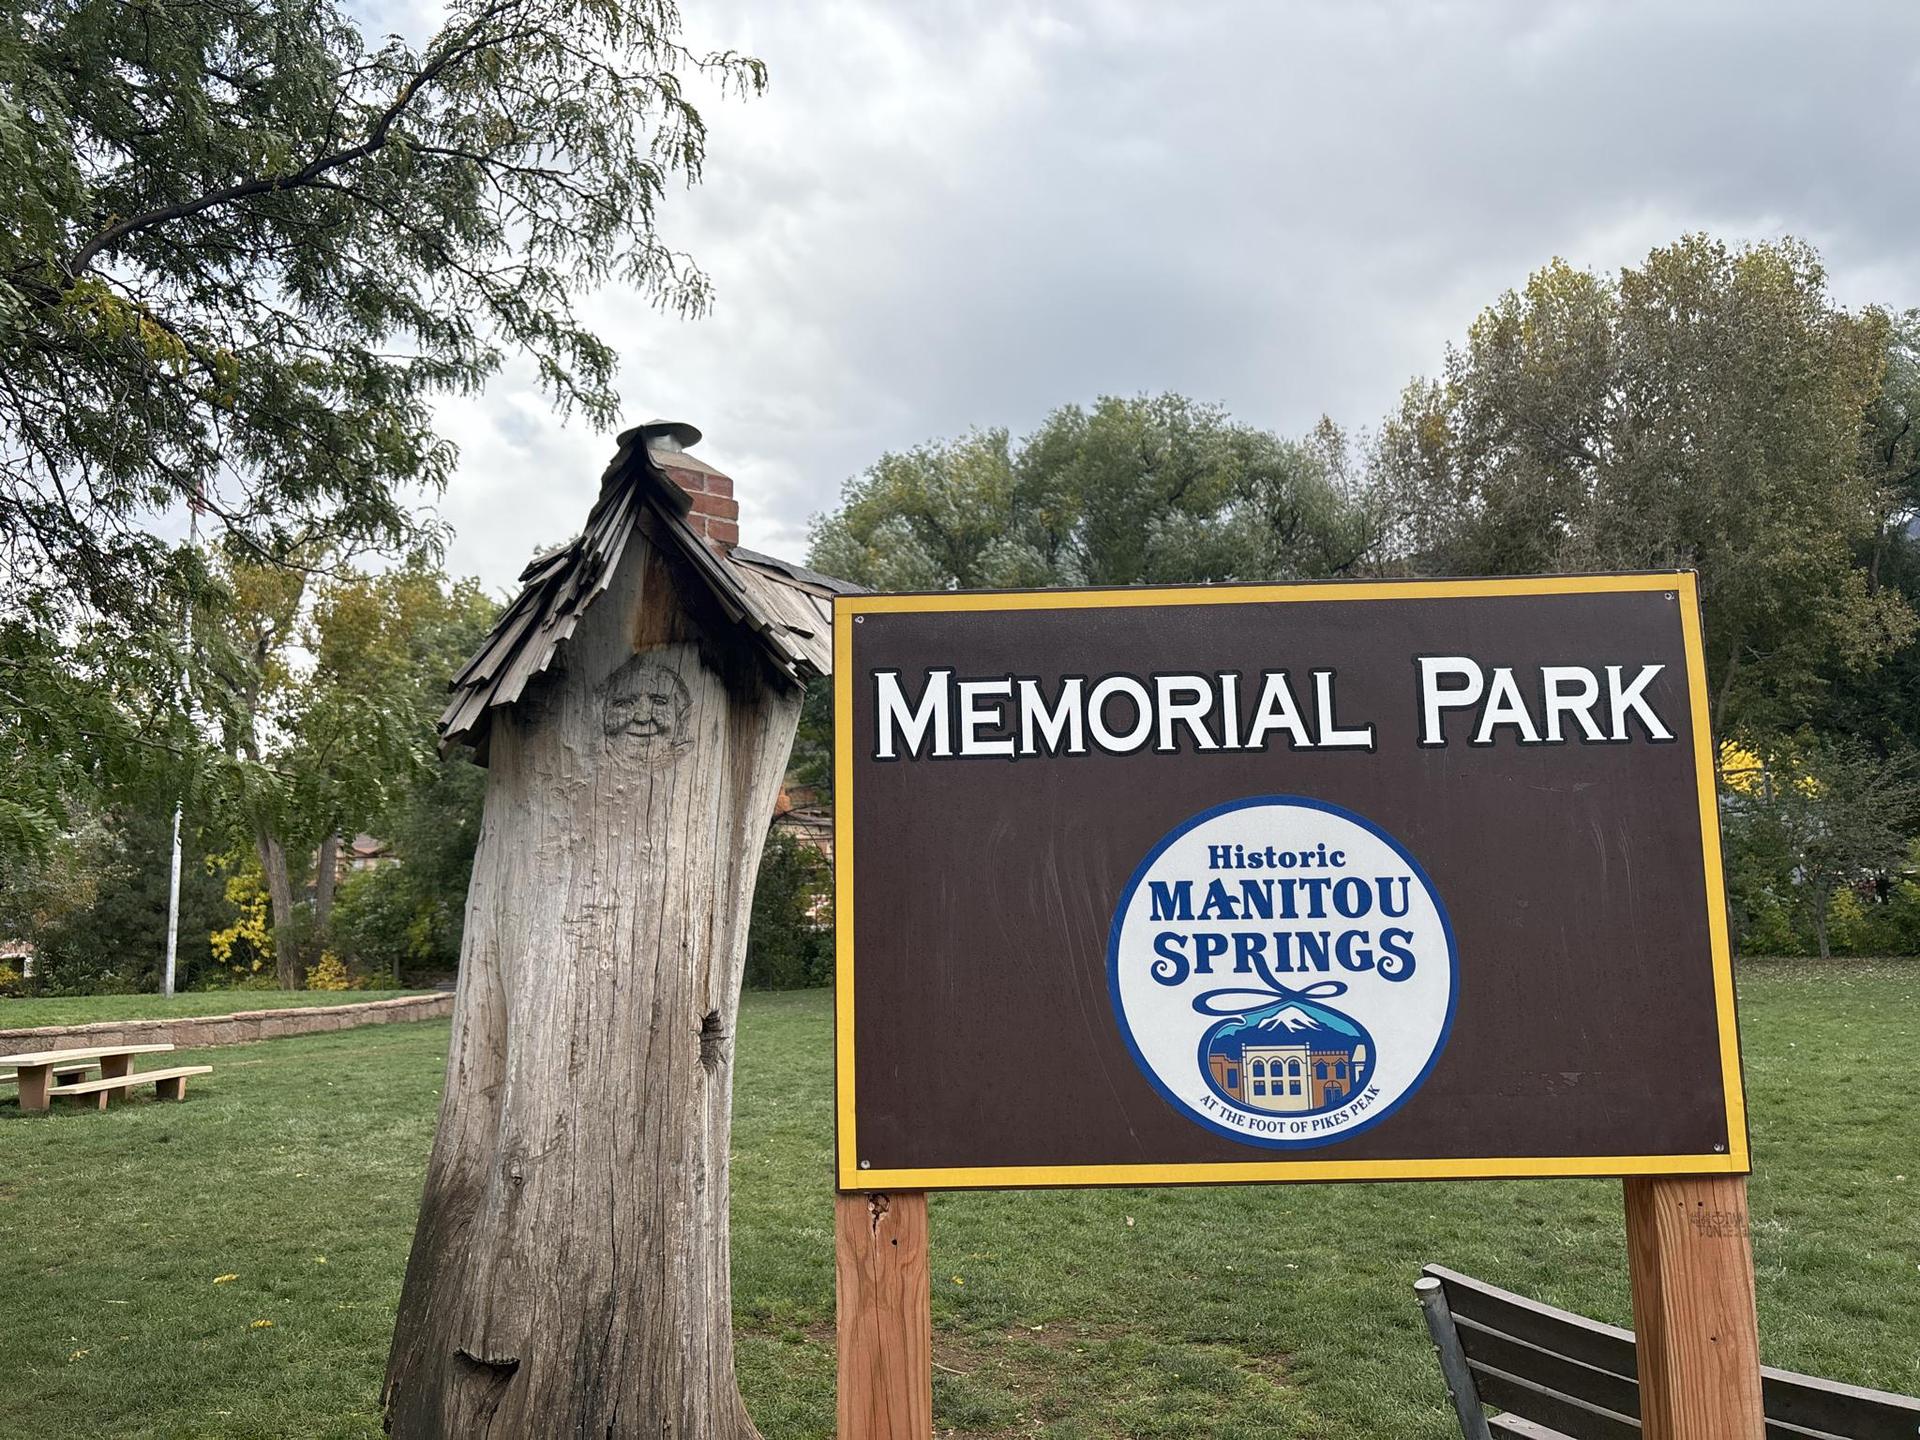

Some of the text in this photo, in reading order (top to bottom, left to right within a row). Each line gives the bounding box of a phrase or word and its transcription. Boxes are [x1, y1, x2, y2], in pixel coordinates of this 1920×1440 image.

[873, 655, 1675, 759] MEMORIAL PARK
[1208, 843, 1347, 869] Historic
[1148, 877, 1411, 921] MANITOU
[1150, 927, 1417, 987] SPRINGS
[1200, 1085, 1381, 1134] AT THE FOOT OF PIKES PEAK
